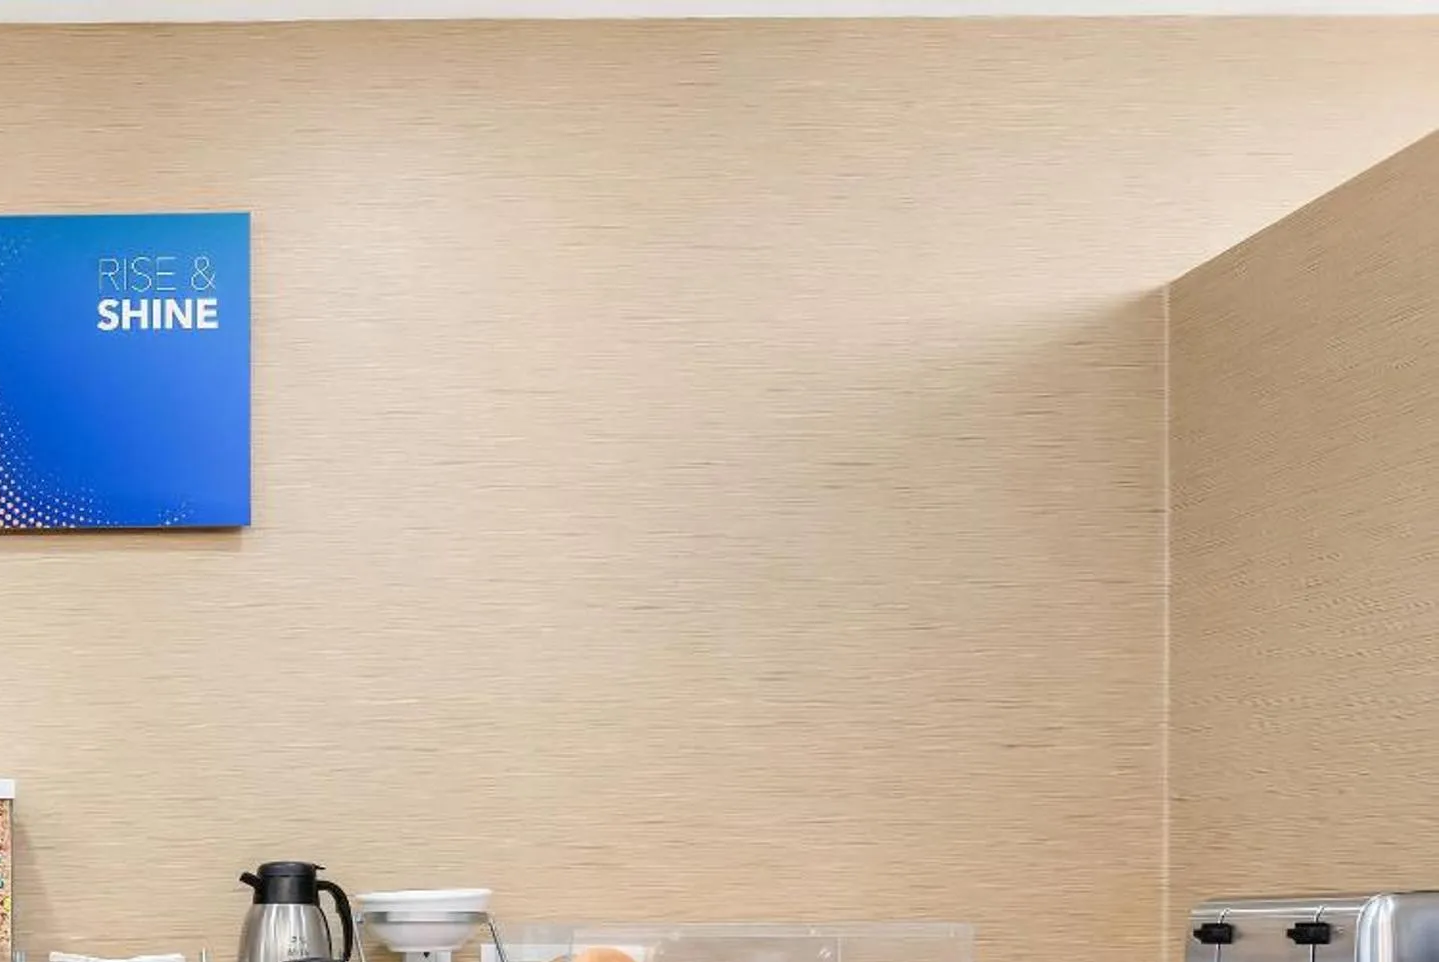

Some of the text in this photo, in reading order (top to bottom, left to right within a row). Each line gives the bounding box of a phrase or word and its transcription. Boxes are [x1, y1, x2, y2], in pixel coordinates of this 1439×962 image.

[98, 256, 216, 292] RISE &
[97, 299, 219, 331] SHINE
